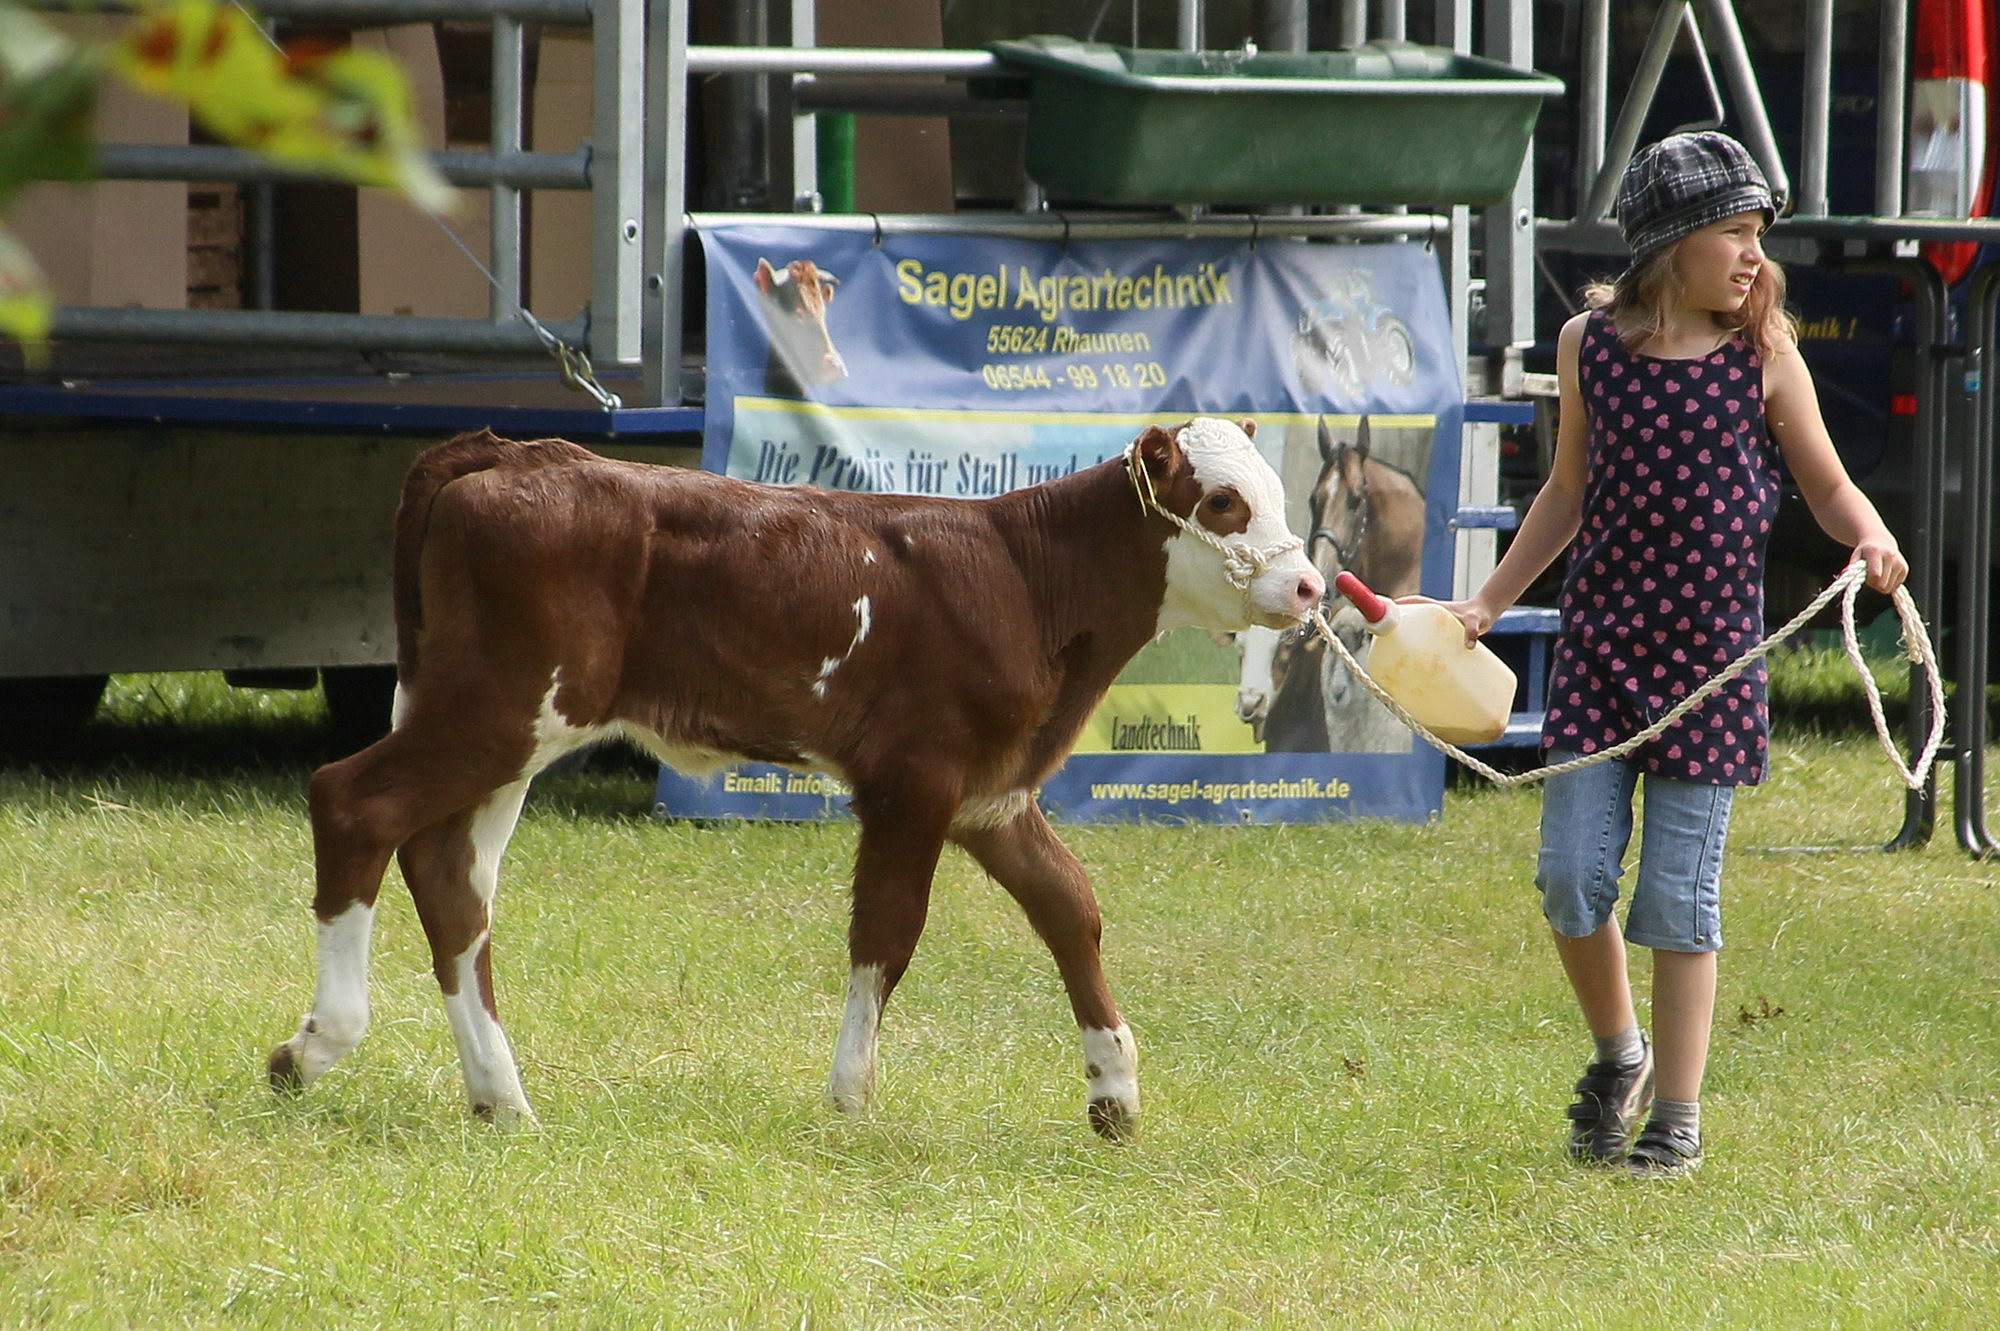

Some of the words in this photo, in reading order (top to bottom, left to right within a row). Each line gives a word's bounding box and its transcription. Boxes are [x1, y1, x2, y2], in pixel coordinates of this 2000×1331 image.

[896, 258, 1008, 321] Sagel
[1014, 263, 1233, 323] Agrartechnik
[986, 325, 1049, 353] 55624
[1051, 326, 1151, 353] Rhaunen
[982, 363, 1052, 391] 06544
[1102, 363, 1131, 389] 18
[1133, 361, 1167, 389] 20
[754, 439, 800, 484] Die
[905, 448, 949, 494] für
[956, 451, 1017, 495] Stall
[1110, 714, 1202, 751] Landtechnik
[723, 772, 782, 793] Email:
[1091, 777, 1350, 804] www.sagel-agrartechnik.de
